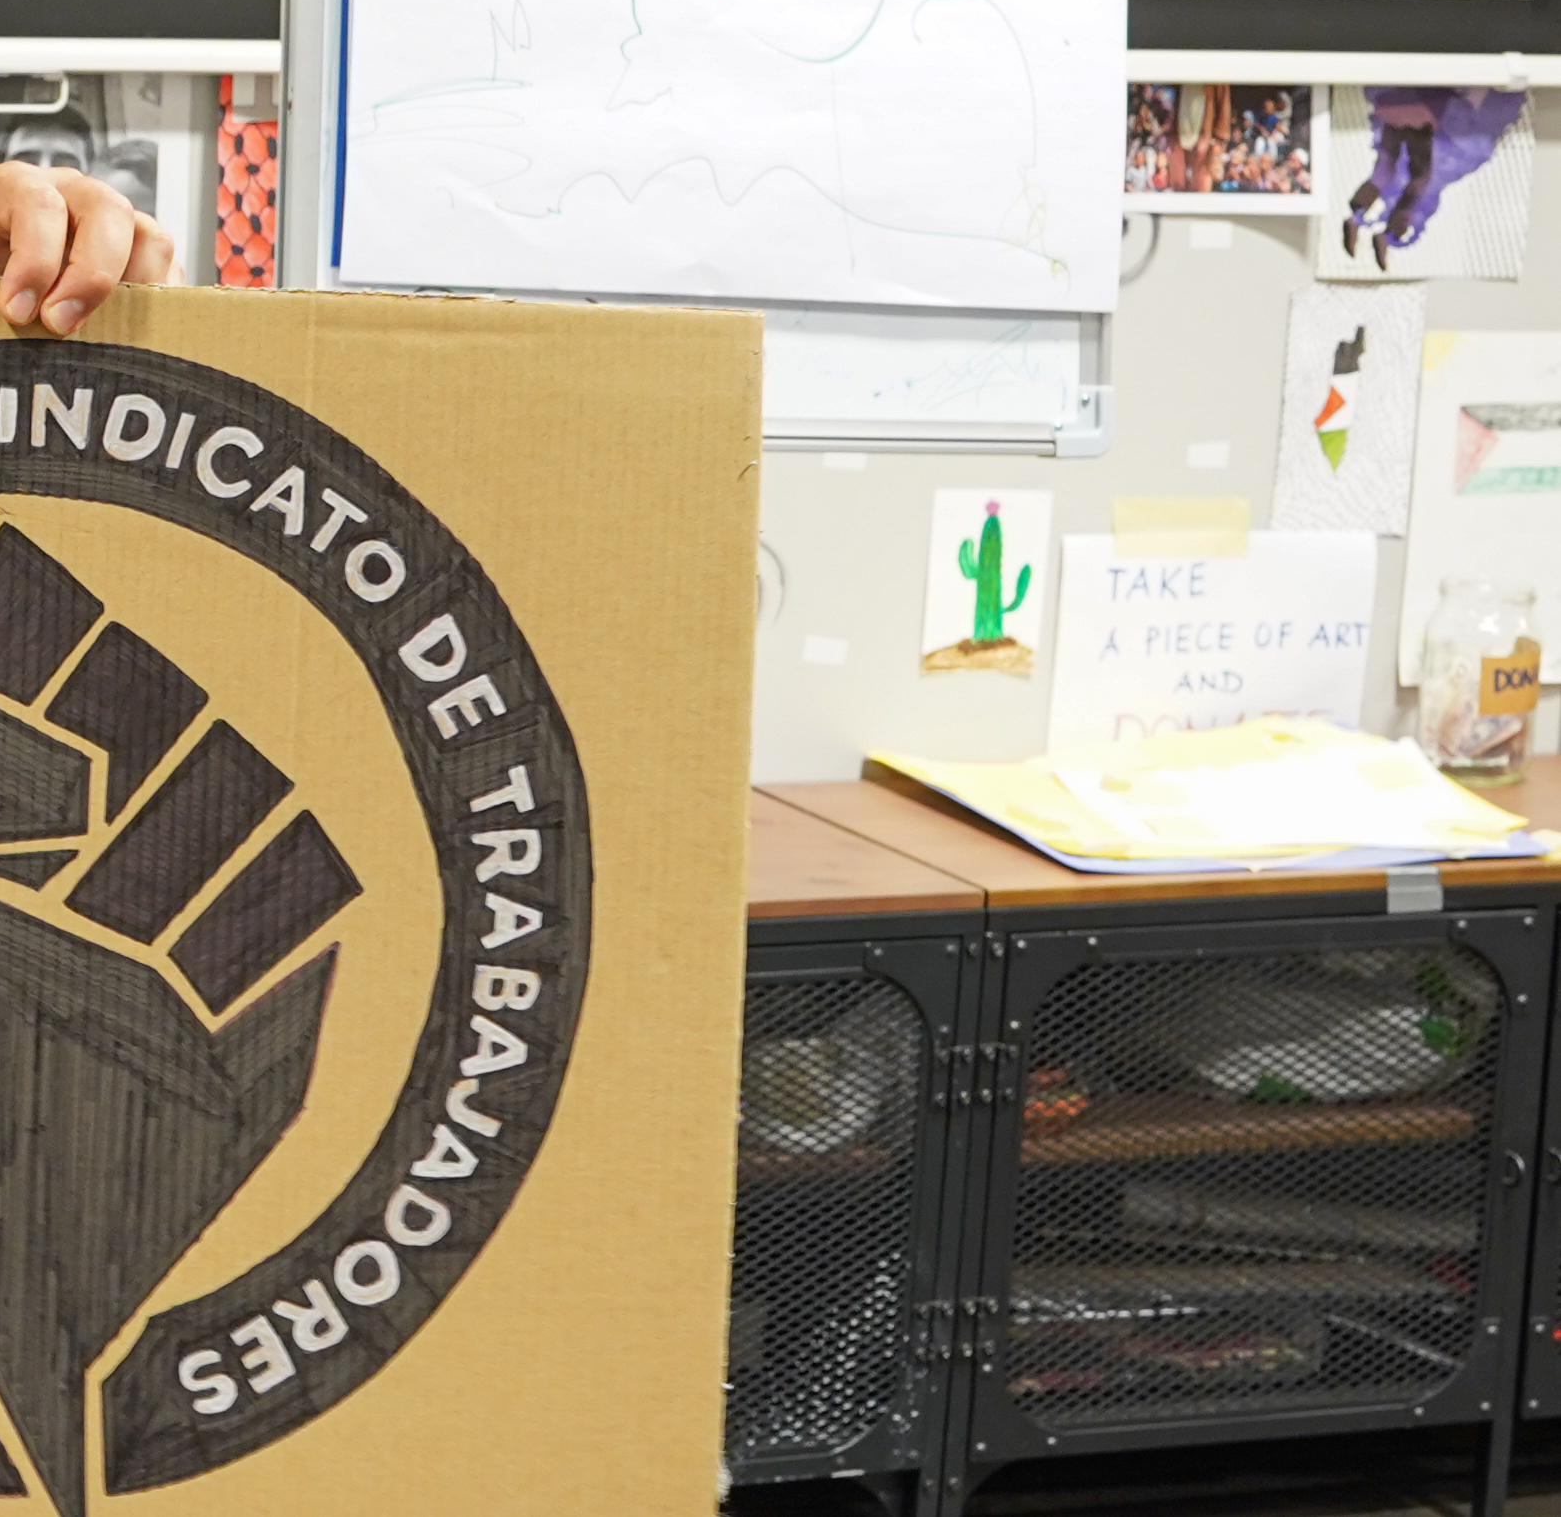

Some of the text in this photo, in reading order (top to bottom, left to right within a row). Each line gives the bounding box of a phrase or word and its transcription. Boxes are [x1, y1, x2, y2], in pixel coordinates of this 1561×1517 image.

[1107, 562, 1207, 602] TAKE
[1099, 621, 1369, 661] A PIECE OF ART
[399, 614, 506, 739] DE
[1174, 670, 1244, 695] AND
[179, 765, 542, 1413] TRABAJADORES
